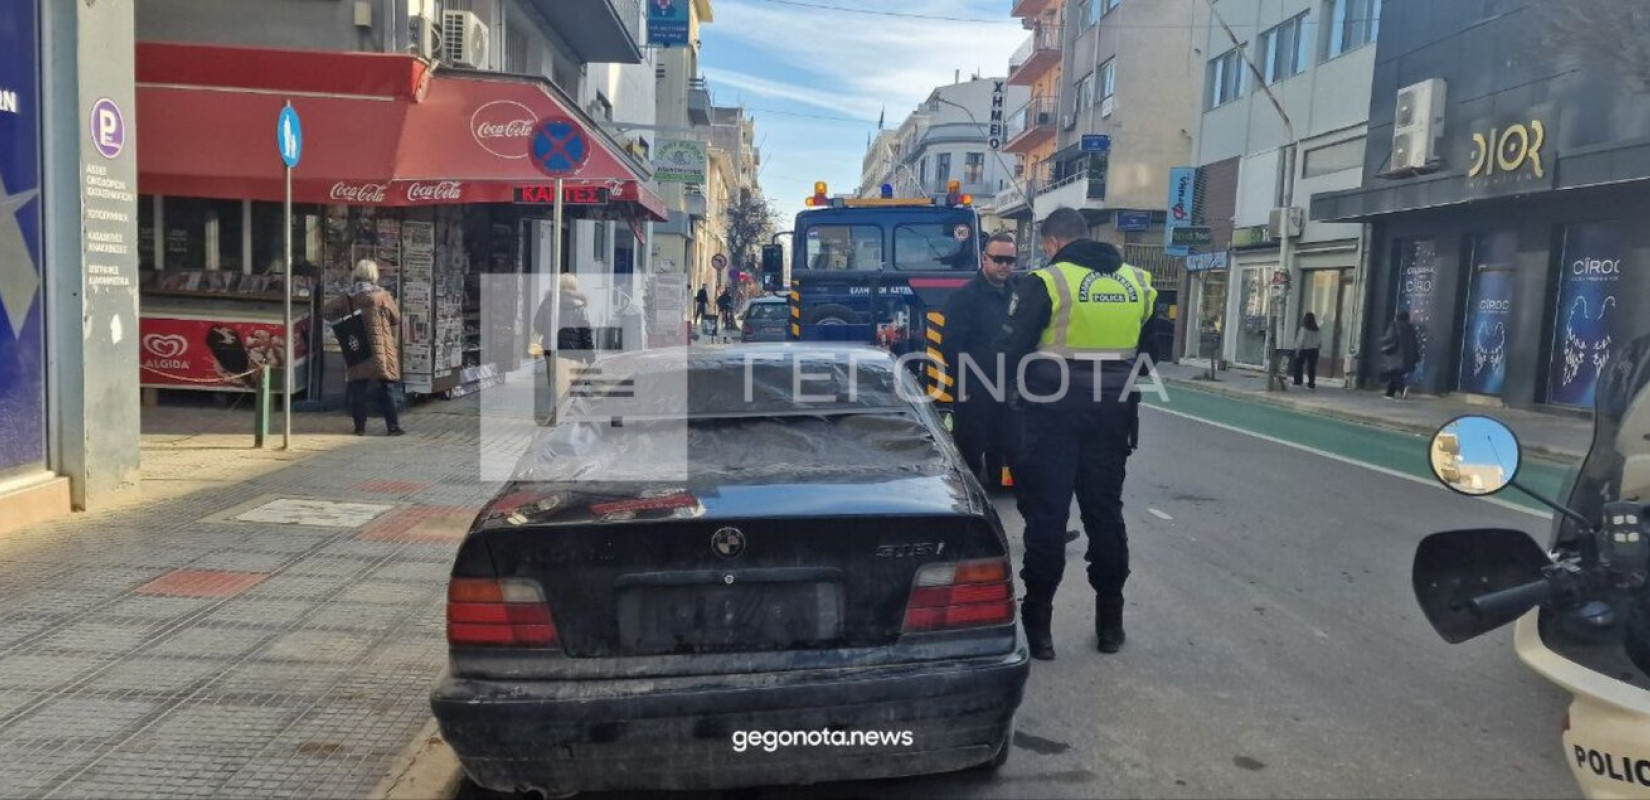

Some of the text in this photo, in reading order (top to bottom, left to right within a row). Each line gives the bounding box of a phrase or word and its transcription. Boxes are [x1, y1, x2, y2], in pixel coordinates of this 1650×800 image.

[989, 81, 1003, 149] ΧΗΜΕΙΟ
[1468, 120, 1544, 178] DIOR
[1095, 294, 1125, 302] POLICE
[144, 359, 190, 370] ALGIDA
